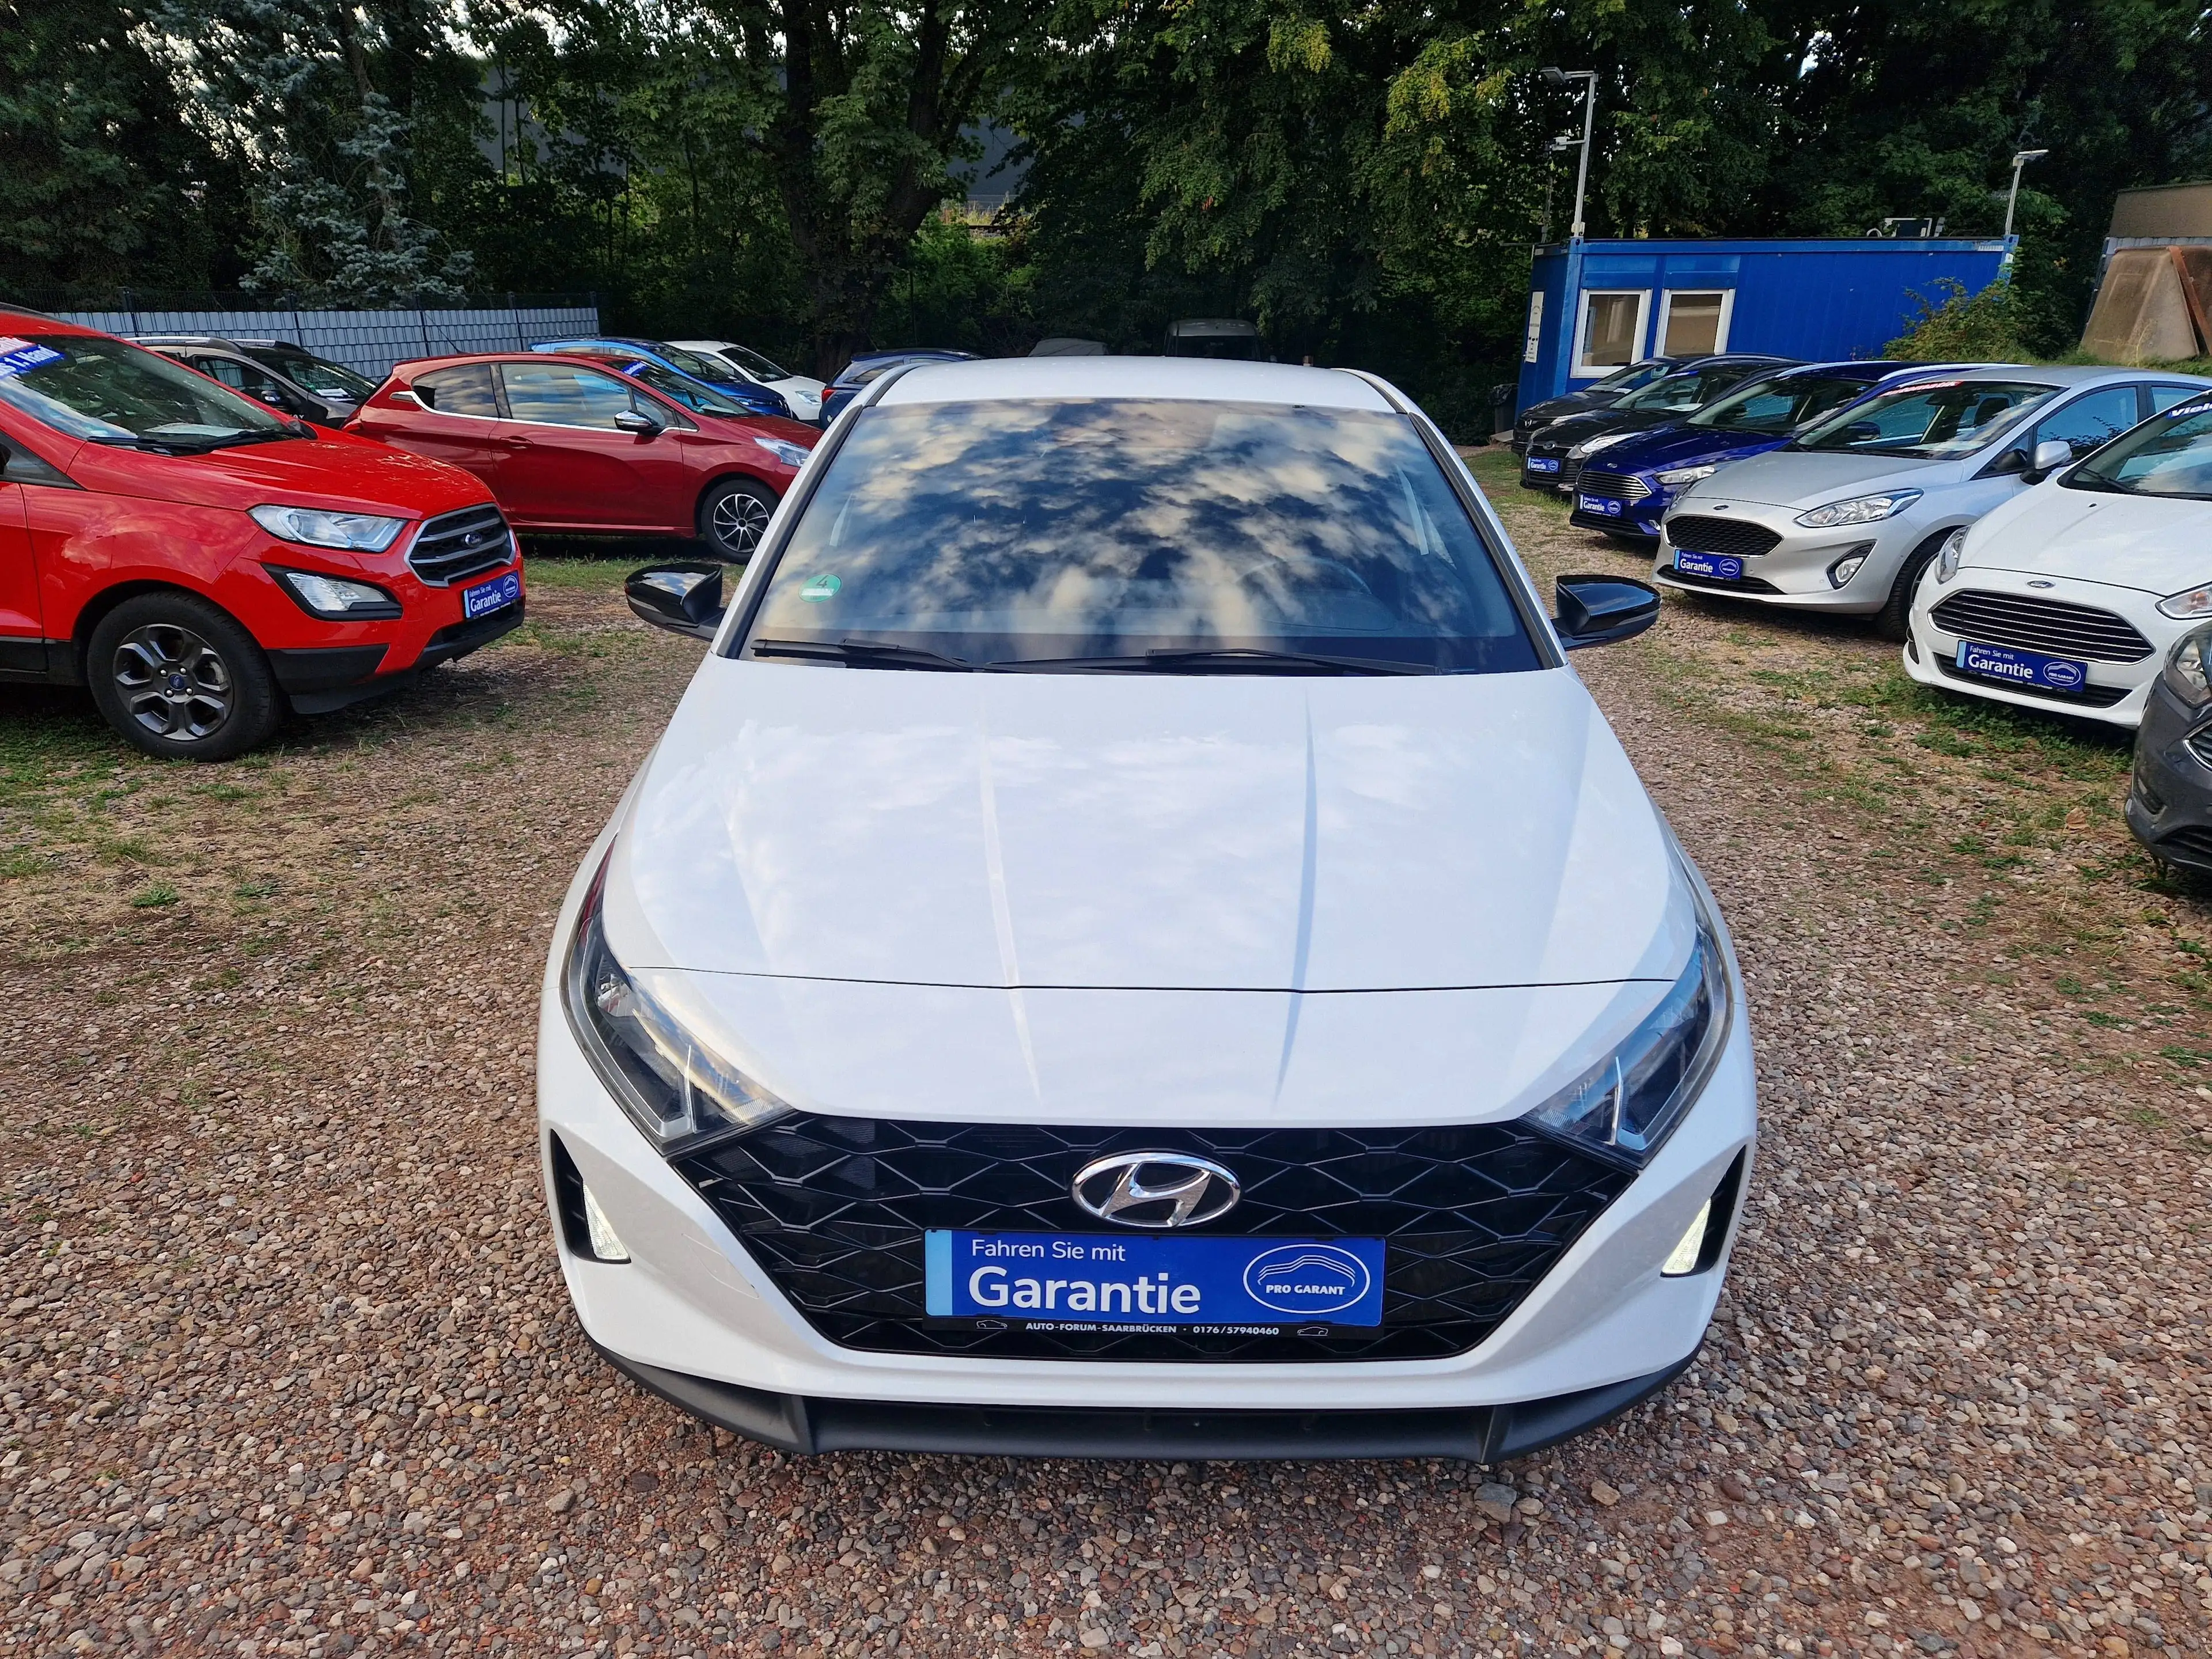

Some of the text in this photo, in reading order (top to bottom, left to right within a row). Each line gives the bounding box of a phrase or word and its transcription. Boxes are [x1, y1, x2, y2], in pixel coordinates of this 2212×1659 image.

[1584, 501, 1605, 512] Garantie
[1680, 558, 1713, 573] Garantie
[816, 575, 828, 588] 4
[470, 589, 501, 612] Garantie
[1970, 646, 1990, 655] Fahren
[1992, 650, 2002, 658] Sie
[1968, 654, 2033, 679] Garantie
[972, 1239, 1126, 1262] Fahren Sie mit
[968, 1266, 1201, 1314] Garantie
[1266, 1285, 1346, 1295] PRO GARANT
[1025, 1322, 1279, 1335] AUTO-FORUM-SAARBRÜCKEN 0176/57940460
